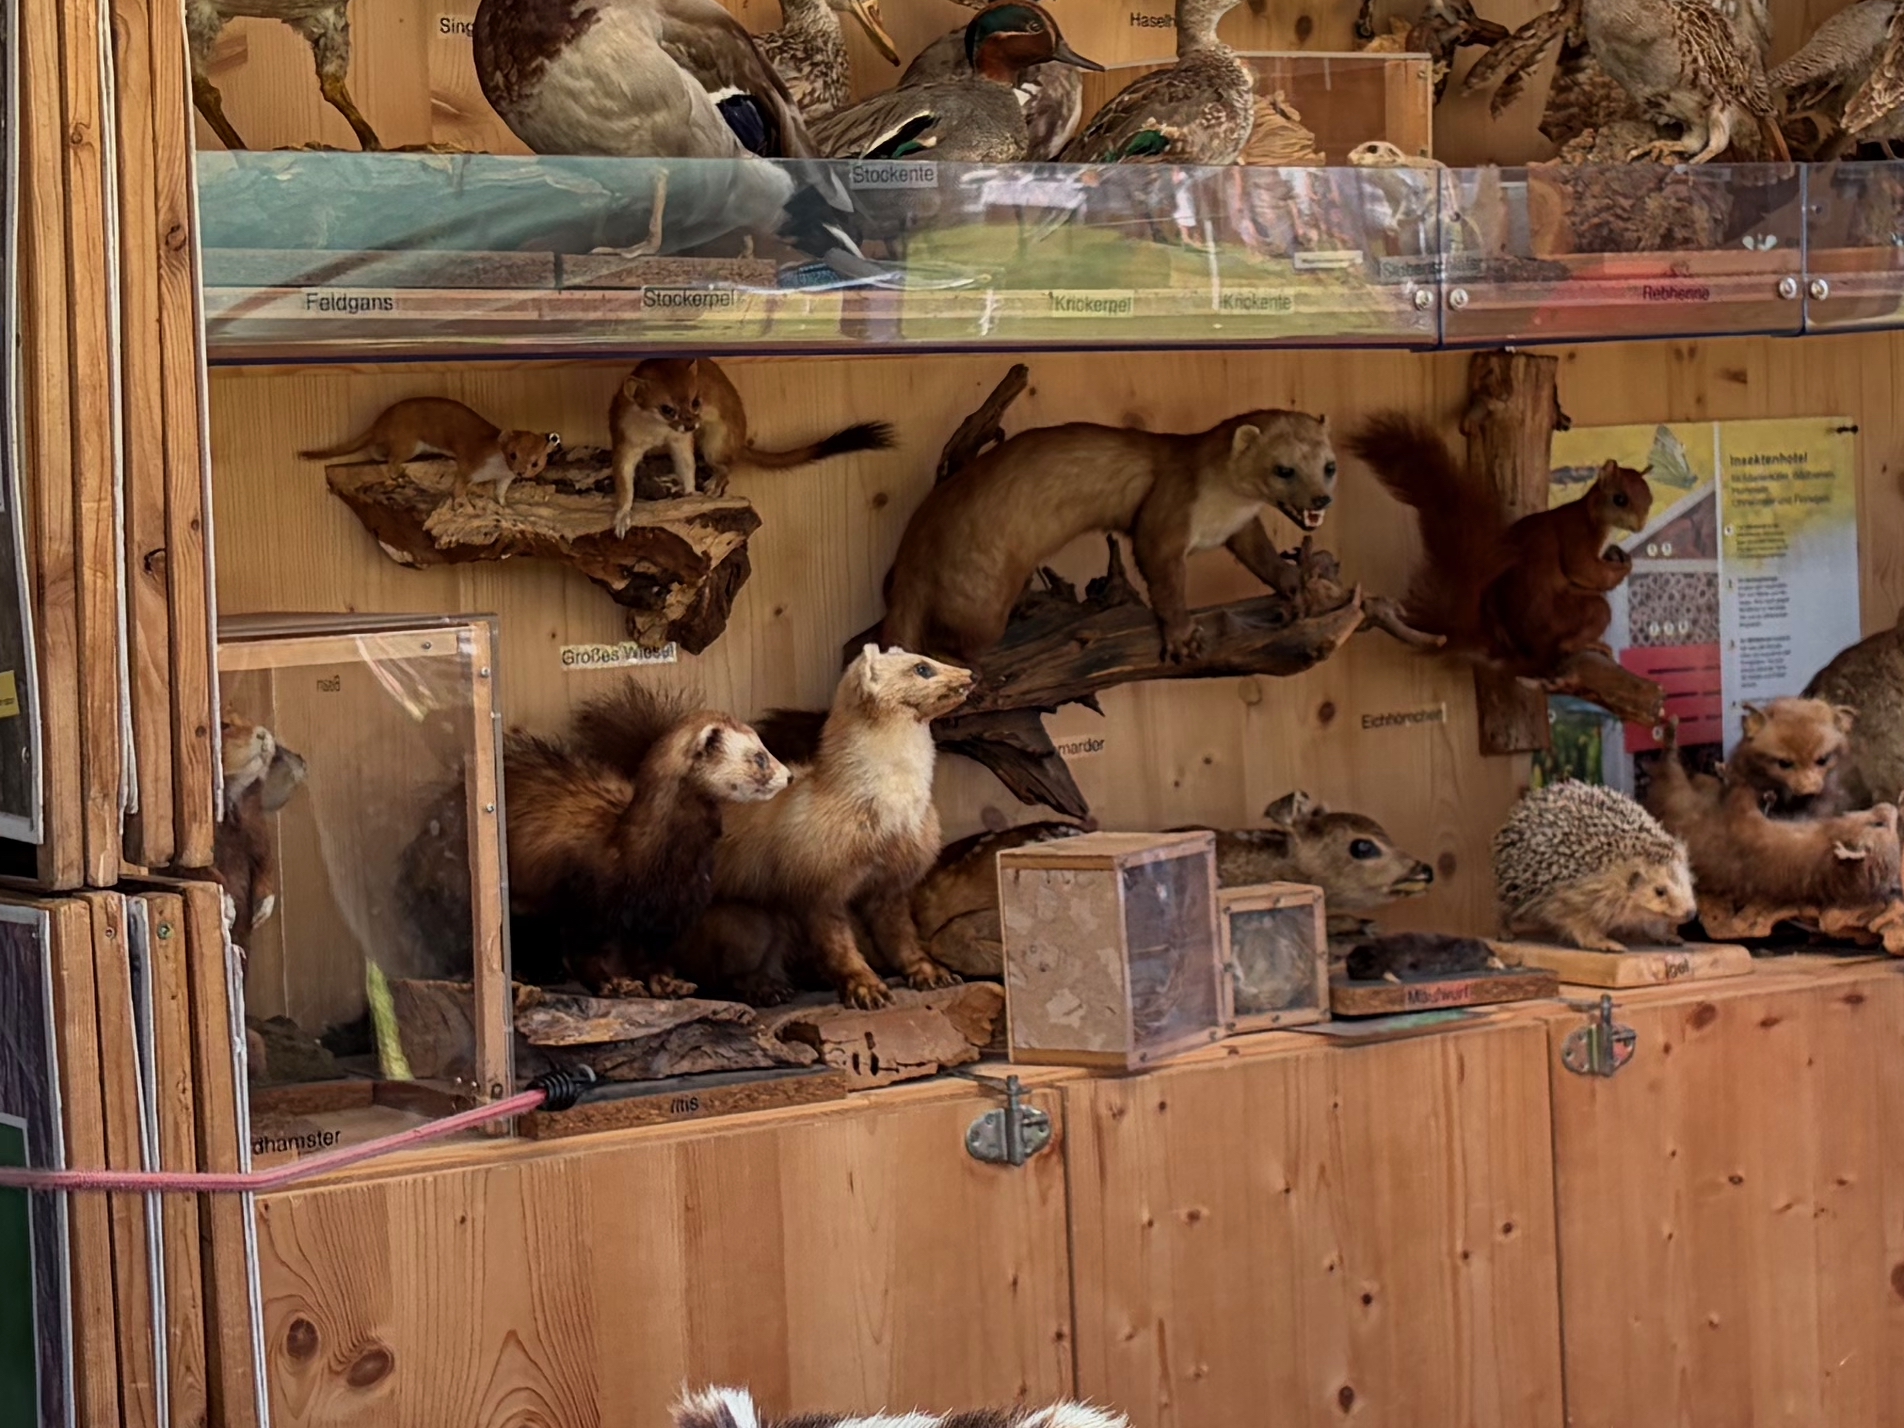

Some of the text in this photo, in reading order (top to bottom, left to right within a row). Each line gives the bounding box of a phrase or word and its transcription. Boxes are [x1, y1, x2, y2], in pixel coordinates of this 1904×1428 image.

[852, 164, 935, 184] Stockente
[642, 288, 735, 309] Stockerpel
[1222, 292, 1293, 311] Krickente
[1642, 283, 1710, 301] Rebhenne
[305, 292, 394, 314] Feldgans
[1053, 294, 1133, 315] Krickerpel
[1729, 452, 1808, 466] Insektenhotel
[561, 648, 620, 666] Großes
